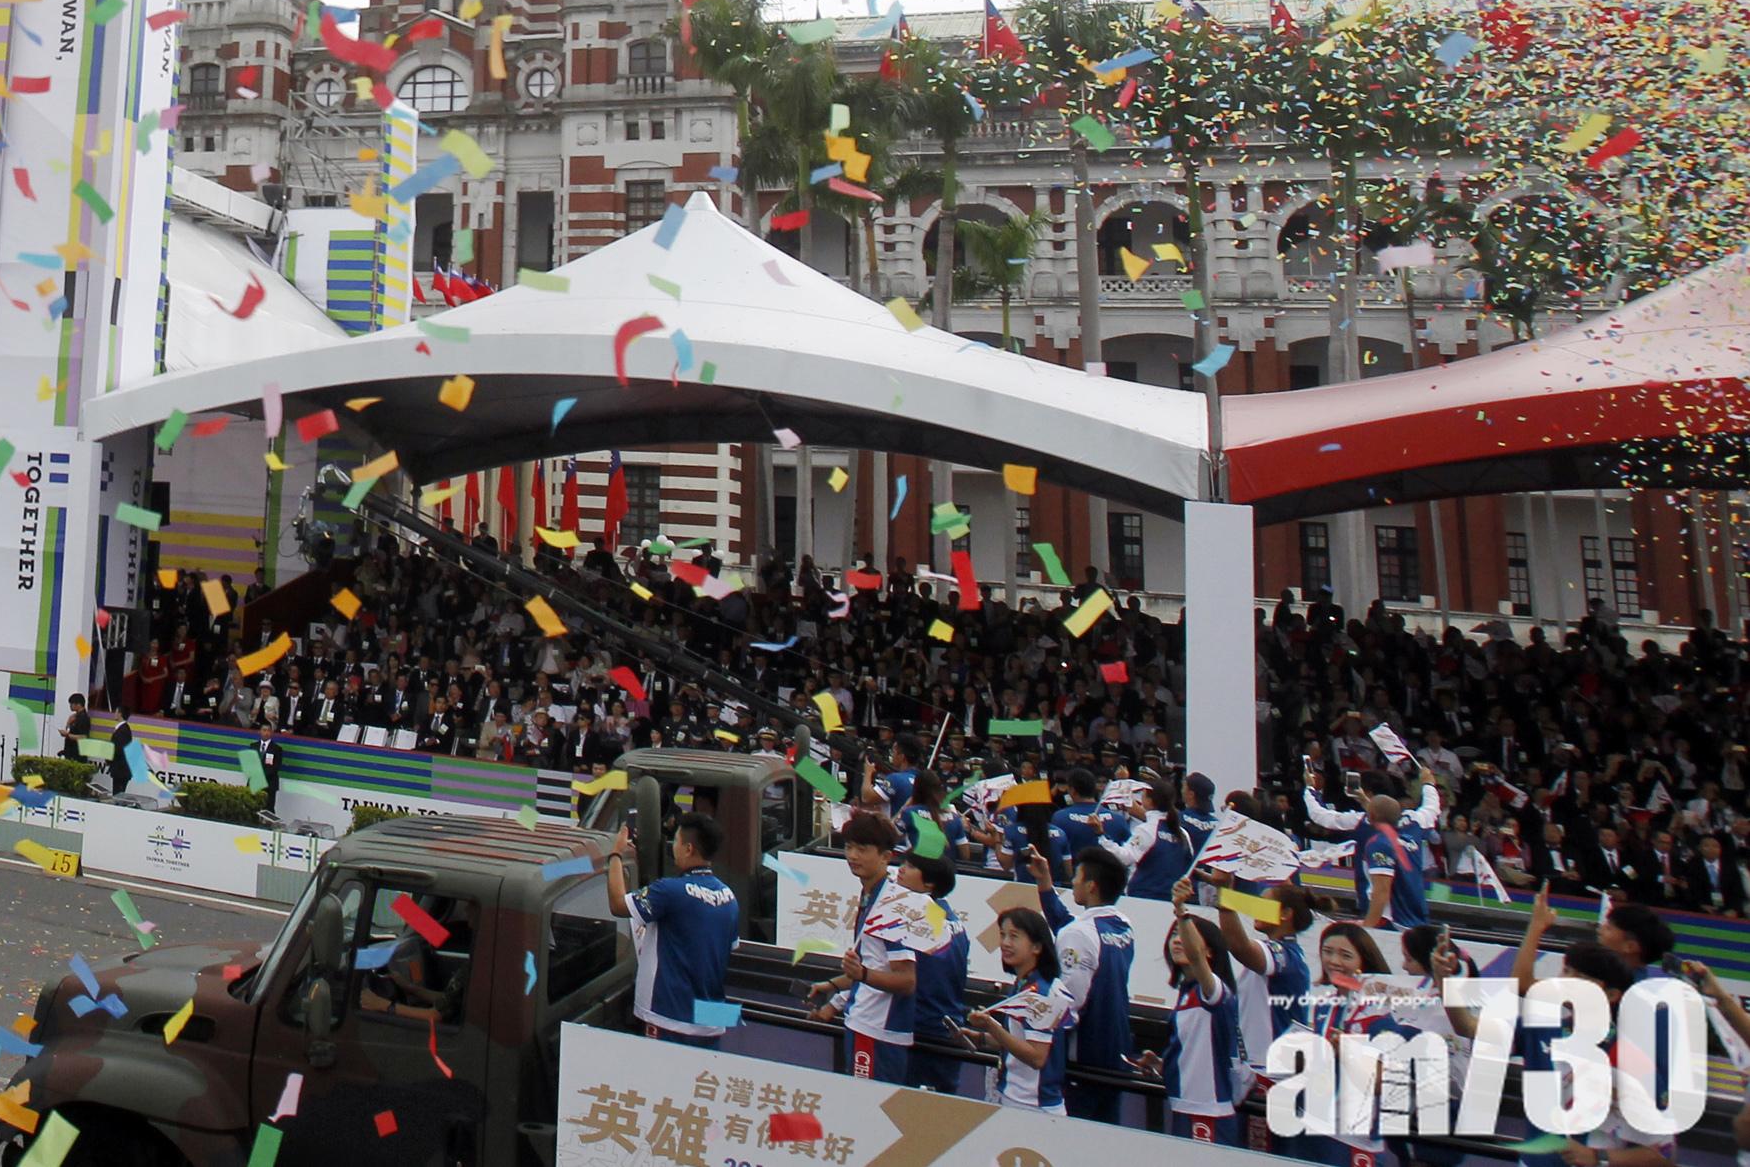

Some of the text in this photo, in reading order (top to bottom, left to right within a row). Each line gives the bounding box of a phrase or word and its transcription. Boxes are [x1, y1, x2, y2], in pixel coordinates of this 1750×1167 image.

[17, 452, 43, 591] TOGETHER
[50, 852, 71, 874] 15
[565, 1083, 712, 1167] 英雄
[693, 1070, 823, 1117] 台灣共好
